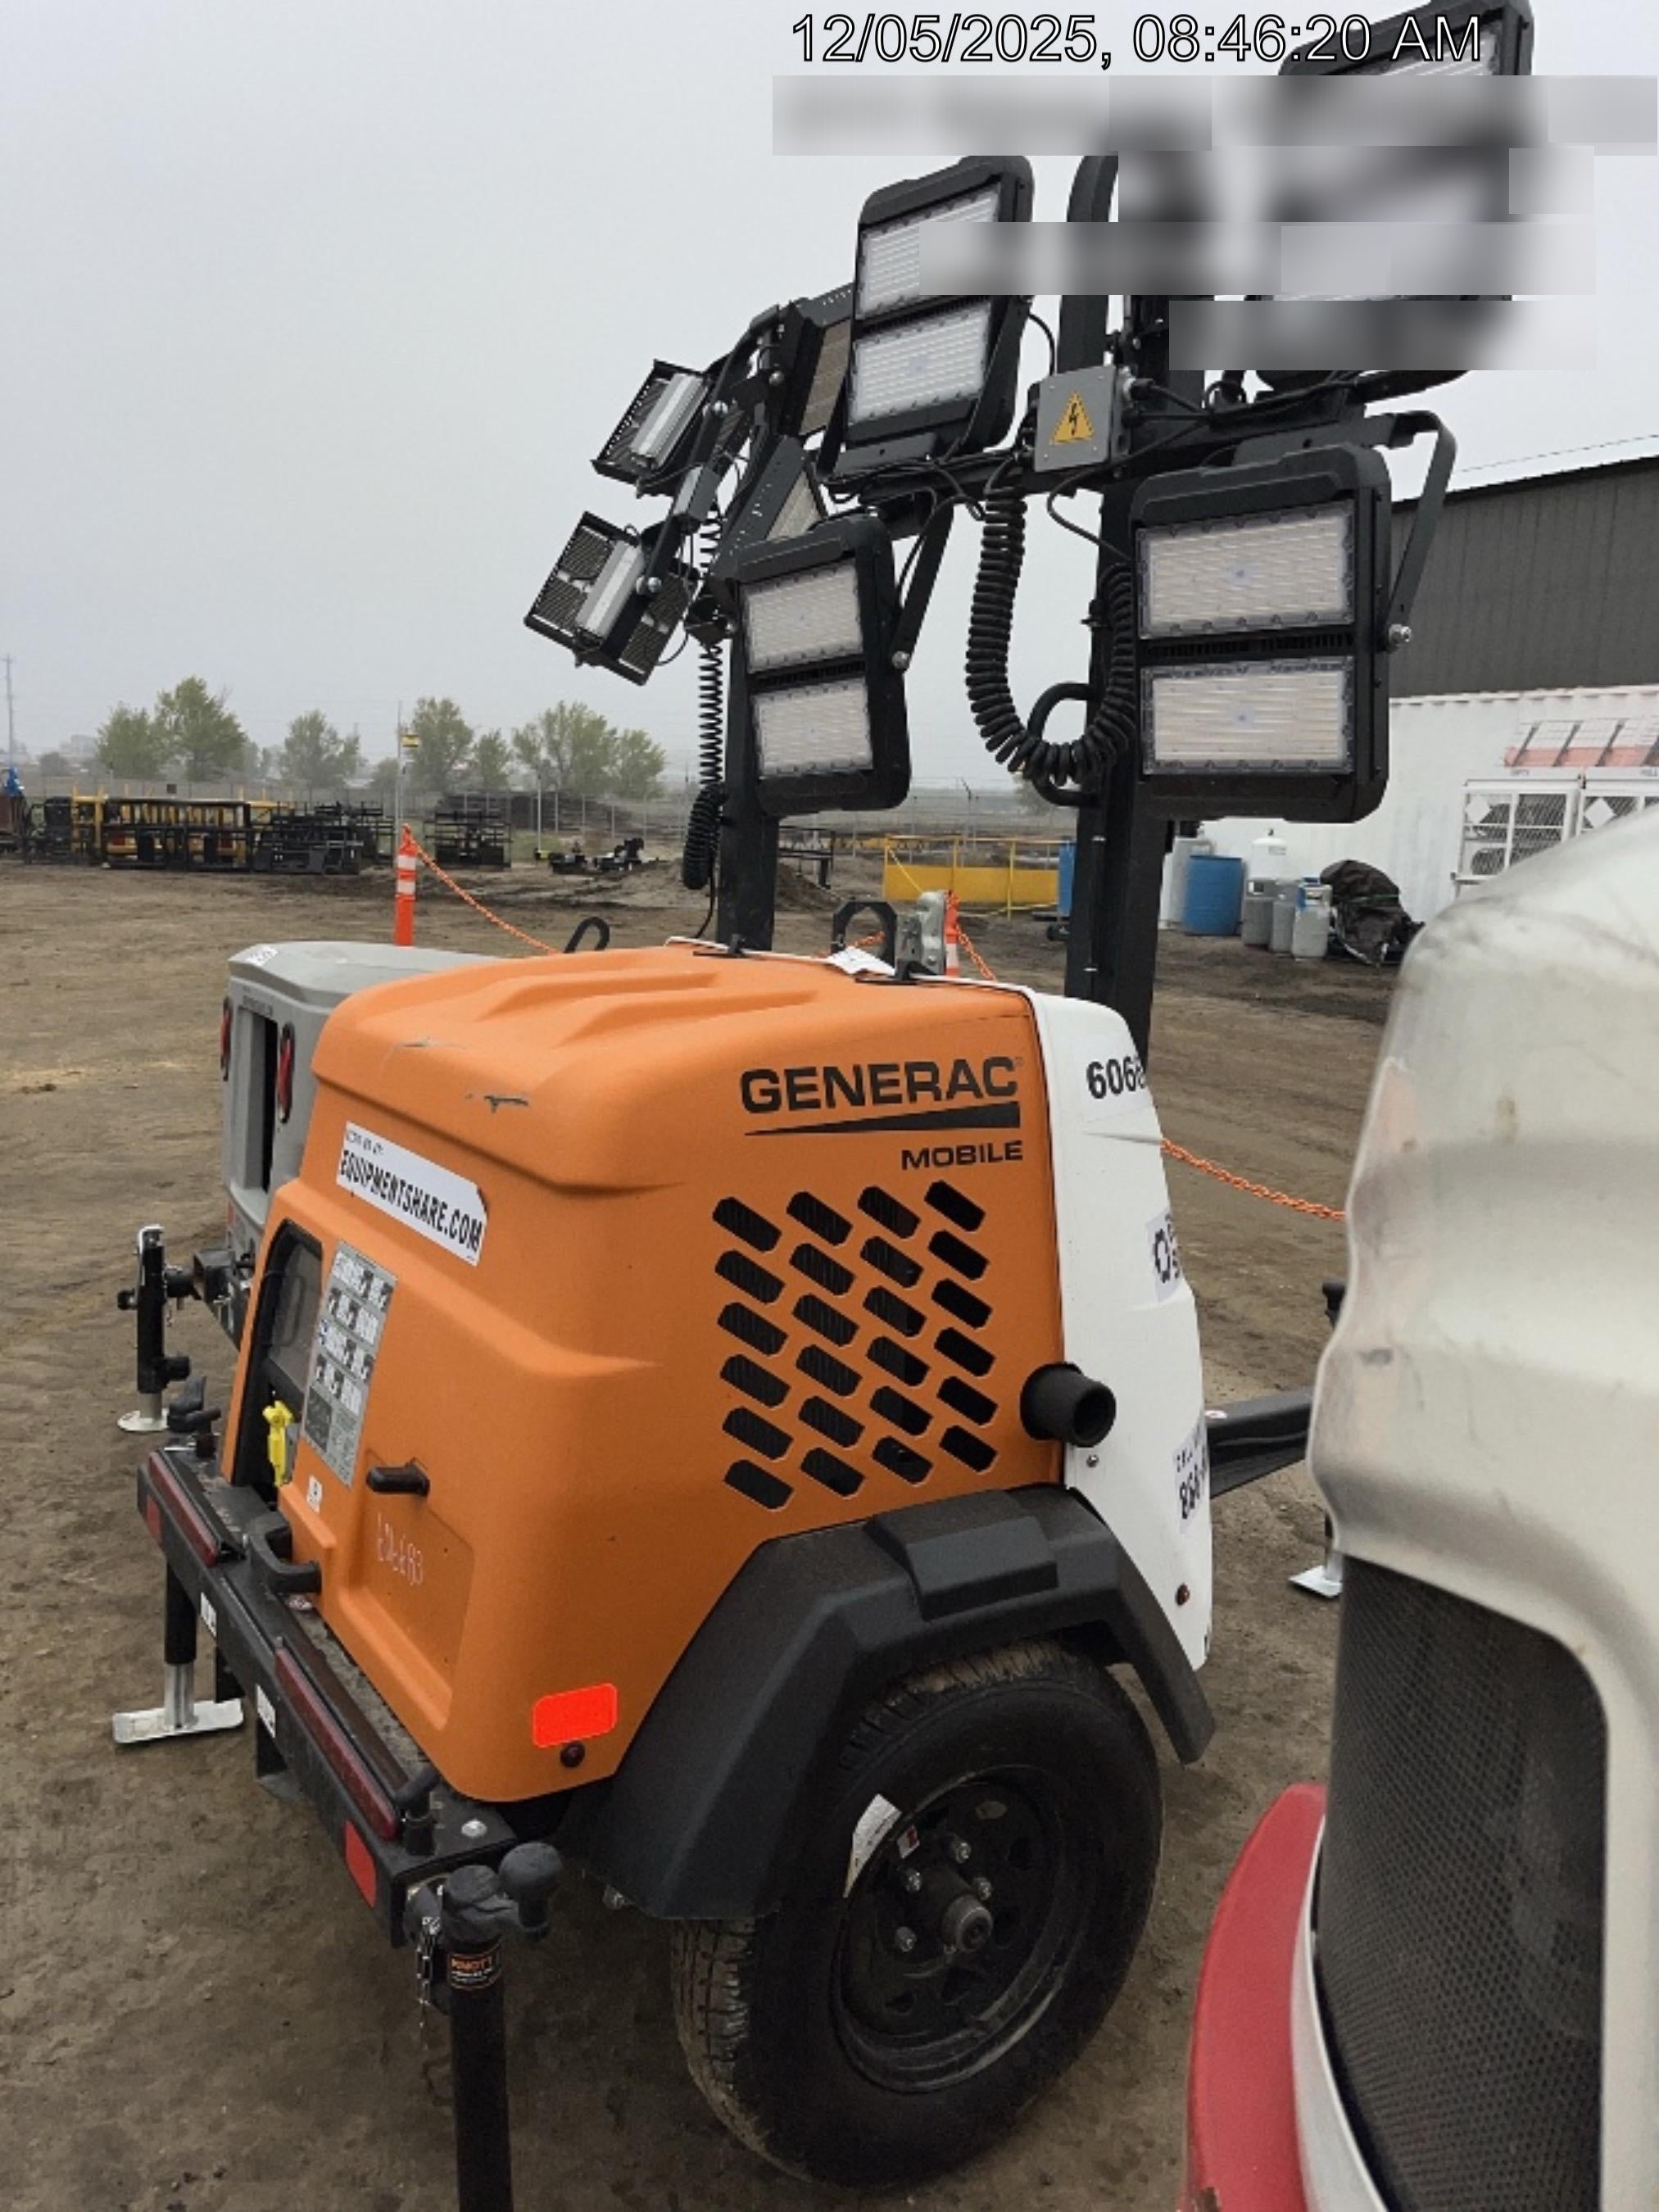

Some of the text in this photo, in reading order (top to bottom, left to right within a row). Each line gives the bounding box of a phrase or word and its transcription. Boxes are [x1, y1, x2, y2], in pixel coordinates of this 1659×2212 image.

[741, 1056, 1018, 1113] GENERAC
[901, 1140, 1023, 1171] MOBILE
[341, 1149, 482, 1253] EQUIPMENTSHARE.COM
